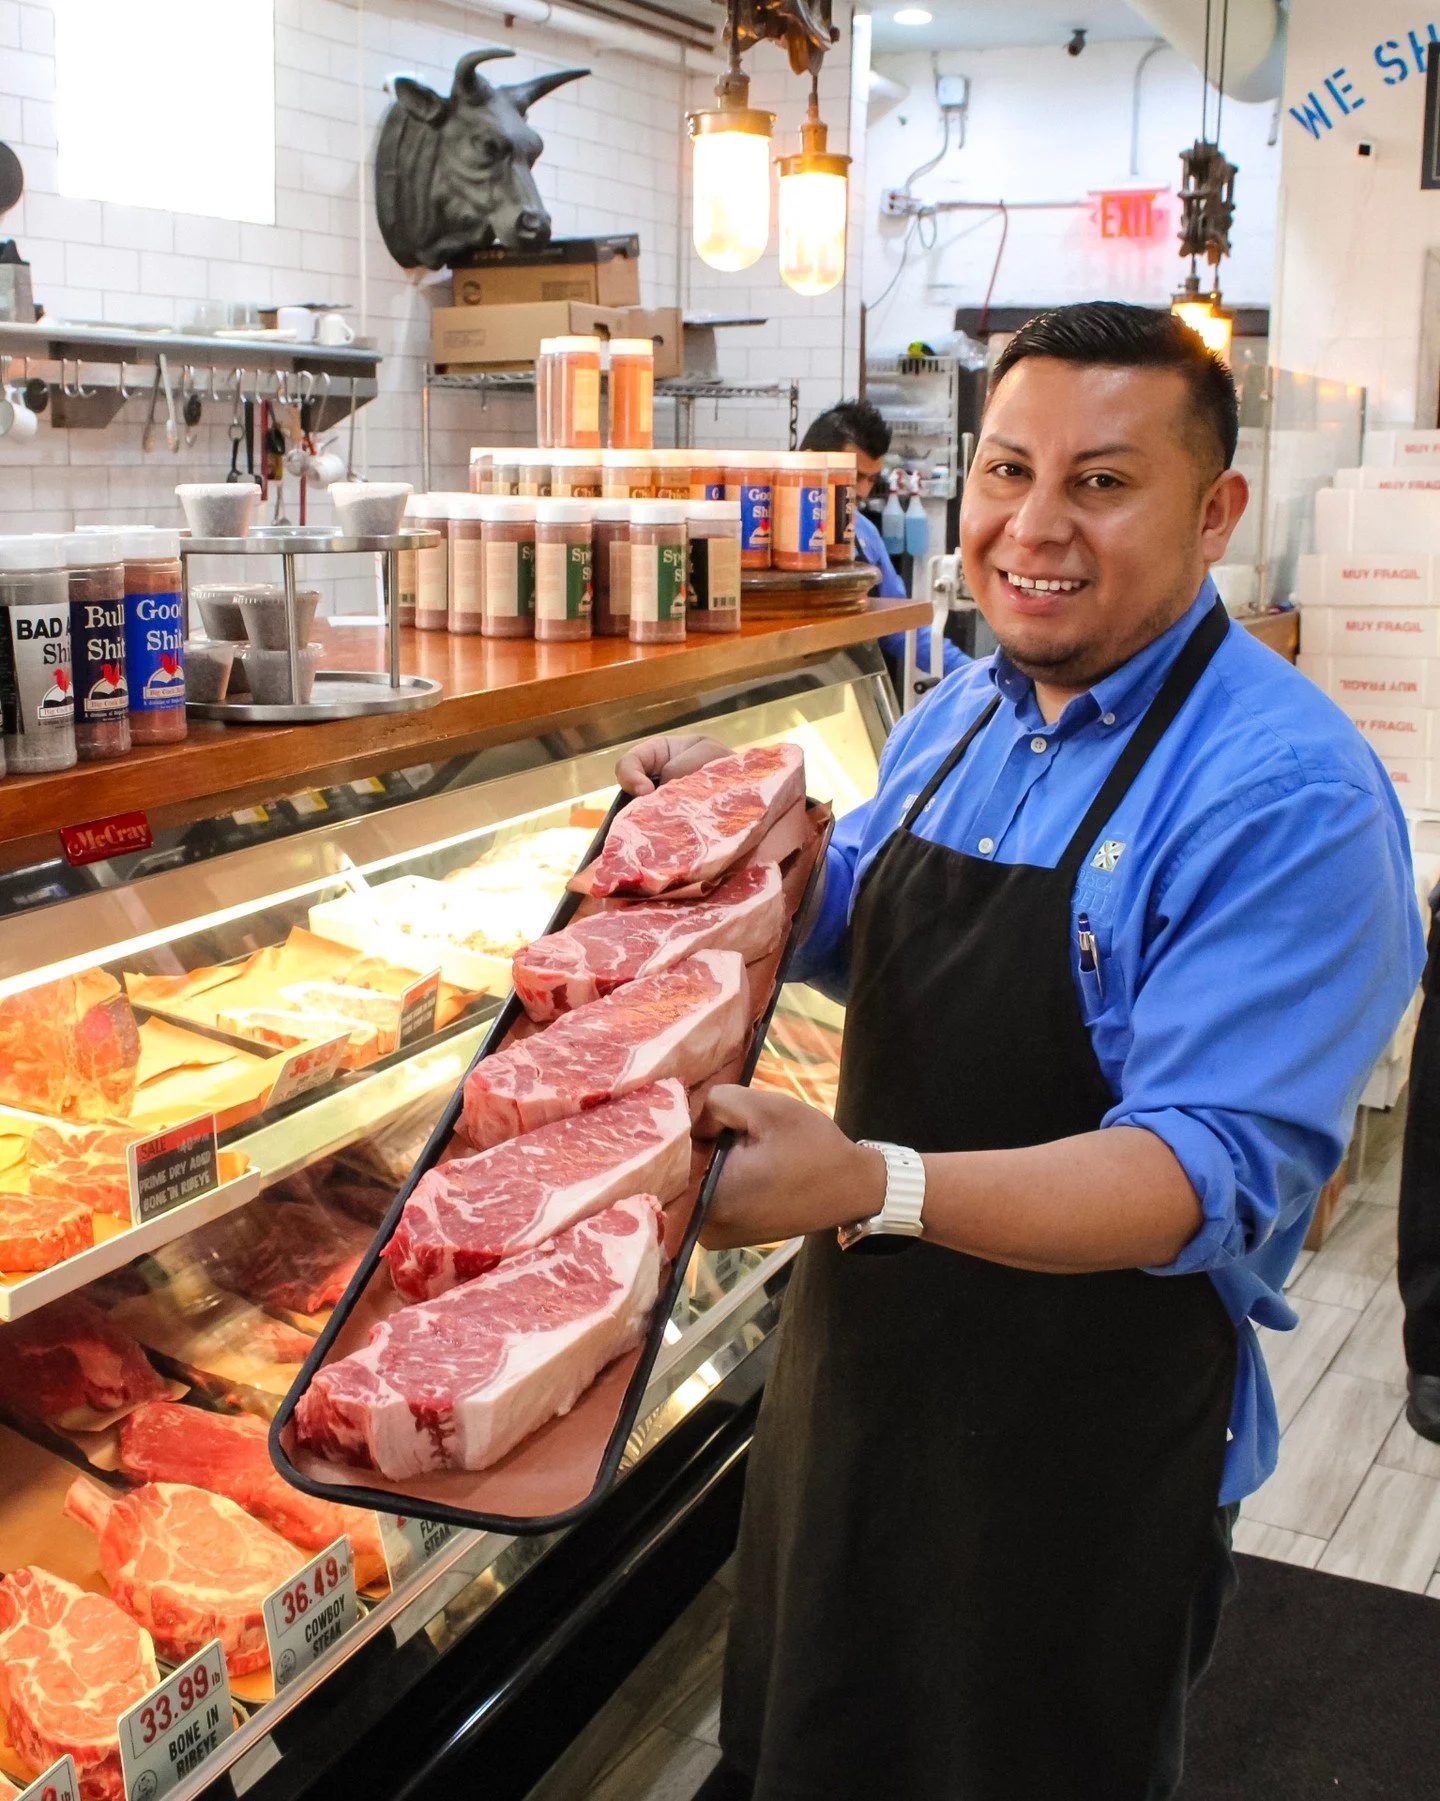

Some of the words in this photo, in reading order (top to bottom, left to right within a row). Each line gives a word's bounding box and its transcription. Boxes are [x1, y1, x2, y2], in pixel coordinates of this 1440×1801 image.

[1289, 67, 1366, 140] WE
[1102, 194, 1156, 238] EXIT
[1404, 443, 1428, 453] MUY
[1379, 481, 1403, 489] MUY
[1342, 569, 1369, 579] MUY
[1373, 569, 1420, 580] FRAGIL
[16, 617, 63, 640] BAD
[84, 604, 125, 629] Bull
[1346, 621, 1373, 631] MUY
[1377, 621, 1423, 632] FRAGIL
[87, 638, 126, 661] Shit
[1340, 680, 1386, 691] FRAGIL
[1390, 681, 1417, 692] MUY
[1370, 720, 1418, 732] FRAGIL
[68, 823, 148, 857] McCray
[168, 1160, 188, 1181] DRY
[281, 1556, 339, 1625] 36.49
[305, 1594, 346, 1644] COWBOY
[312, 1618, 343, 1659] STEAK
[139, 1664, 210, 1744] 33.99
[211, 1671, 221, 1687] lb
[168, 1719, 201, 1763] BONE
[206, 1704, 220, 1730] IN
[176, 1729, 218, 1781] RIBEYE
